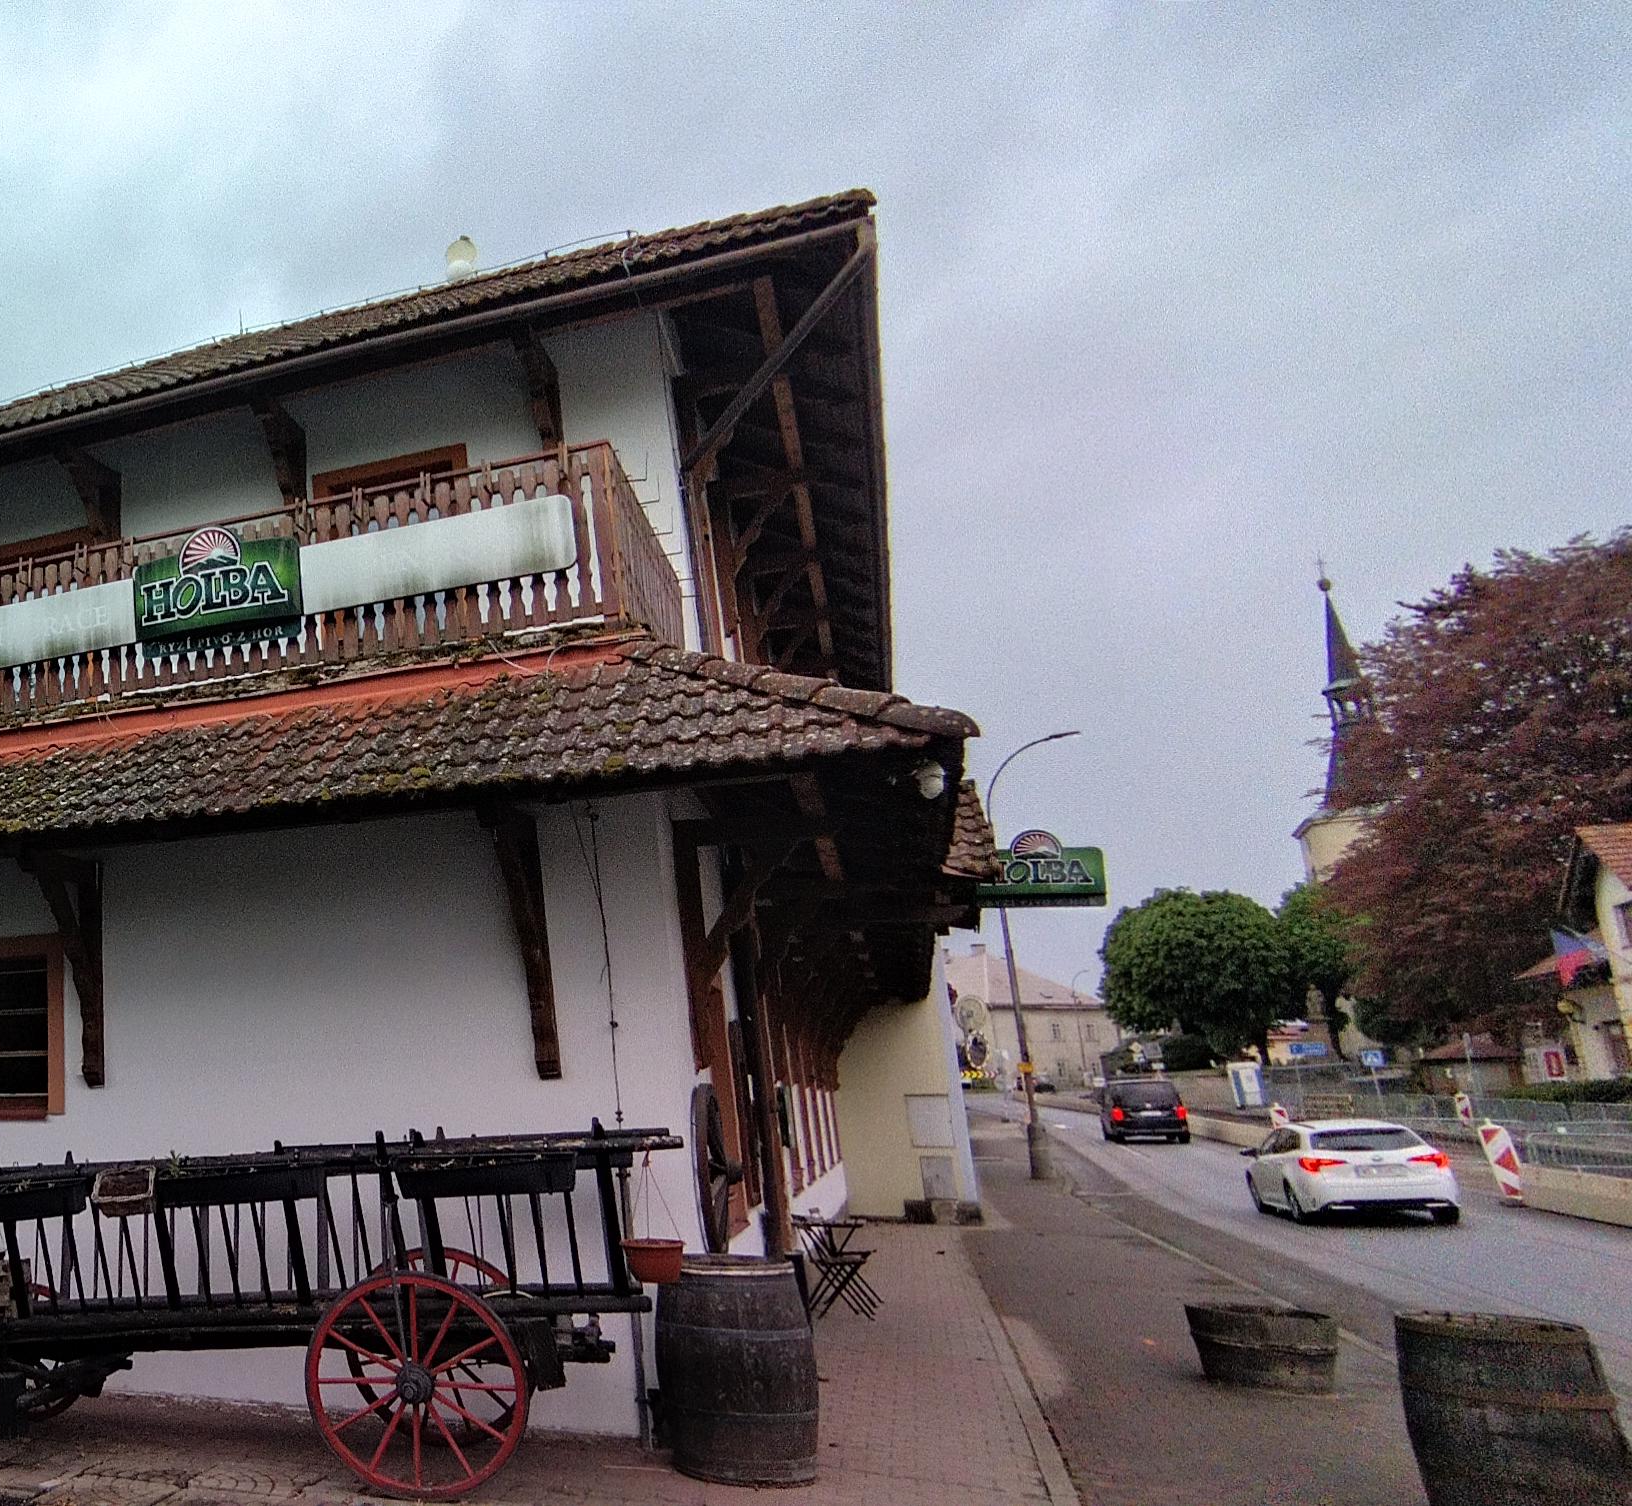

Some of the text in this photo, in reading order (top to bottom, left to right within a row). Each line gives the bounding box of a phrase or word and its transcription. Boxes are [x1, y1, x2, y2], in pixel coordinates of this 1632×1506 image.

[140, 561, 289, 626] HOLBA
[236, 631, 247, 643] Z
[252, 625, 284, 640] HOR
